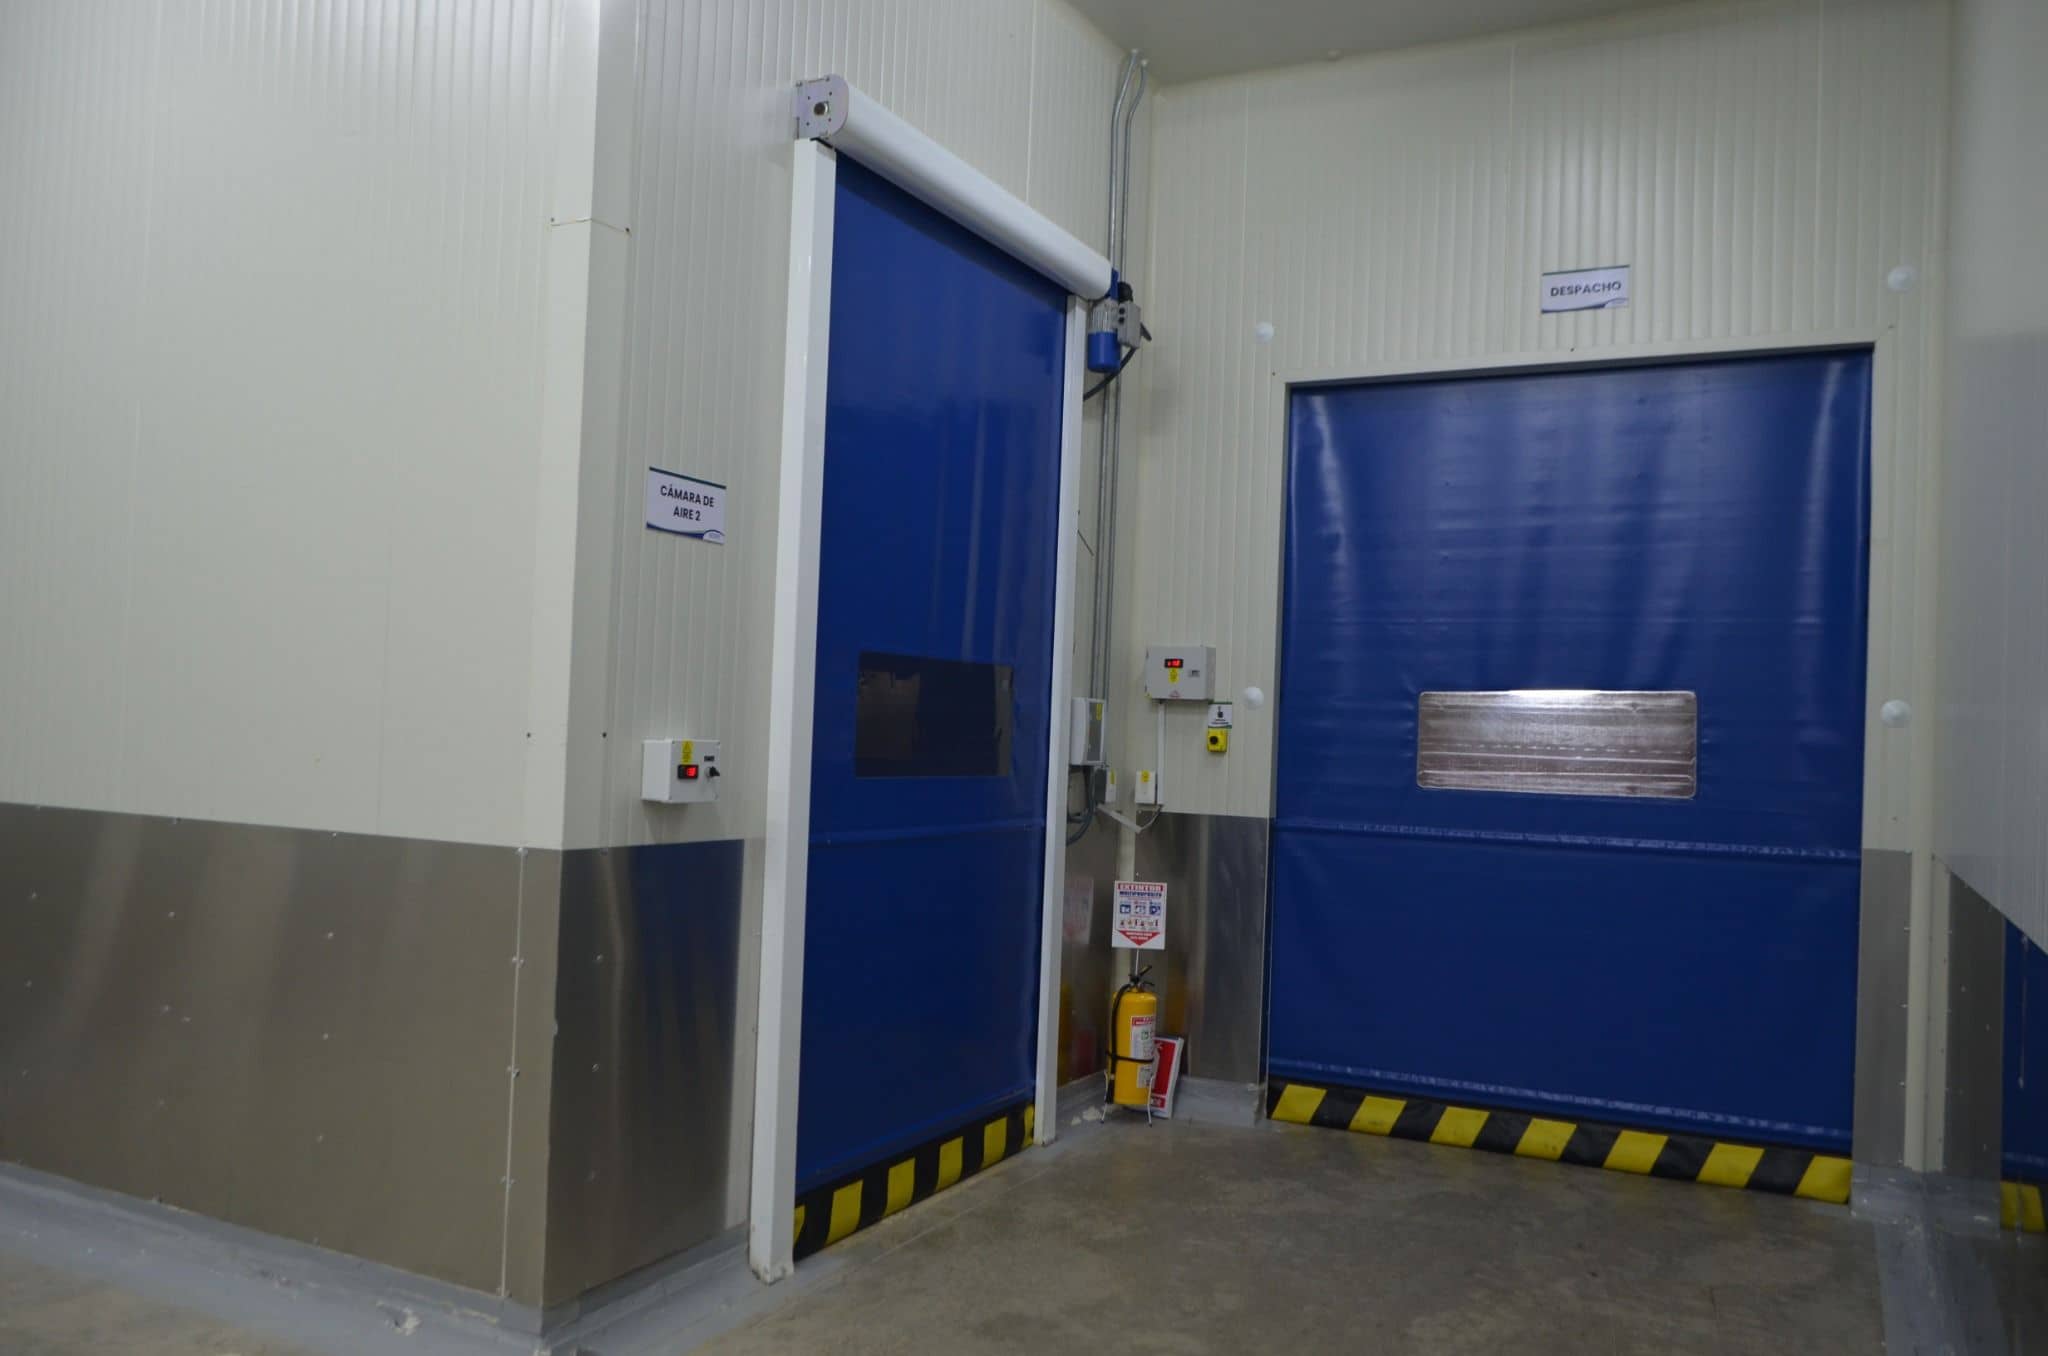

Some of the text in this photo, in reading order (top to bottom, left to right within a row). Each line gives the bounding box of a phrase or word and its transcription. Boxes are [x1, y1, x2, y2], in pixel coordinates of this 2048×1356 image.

[1550, 281, 1622, 297] DESPACHO
[660, 484, 715, 508] CÁMARA DE
[673, 506, 702, 521] AIRE 2
